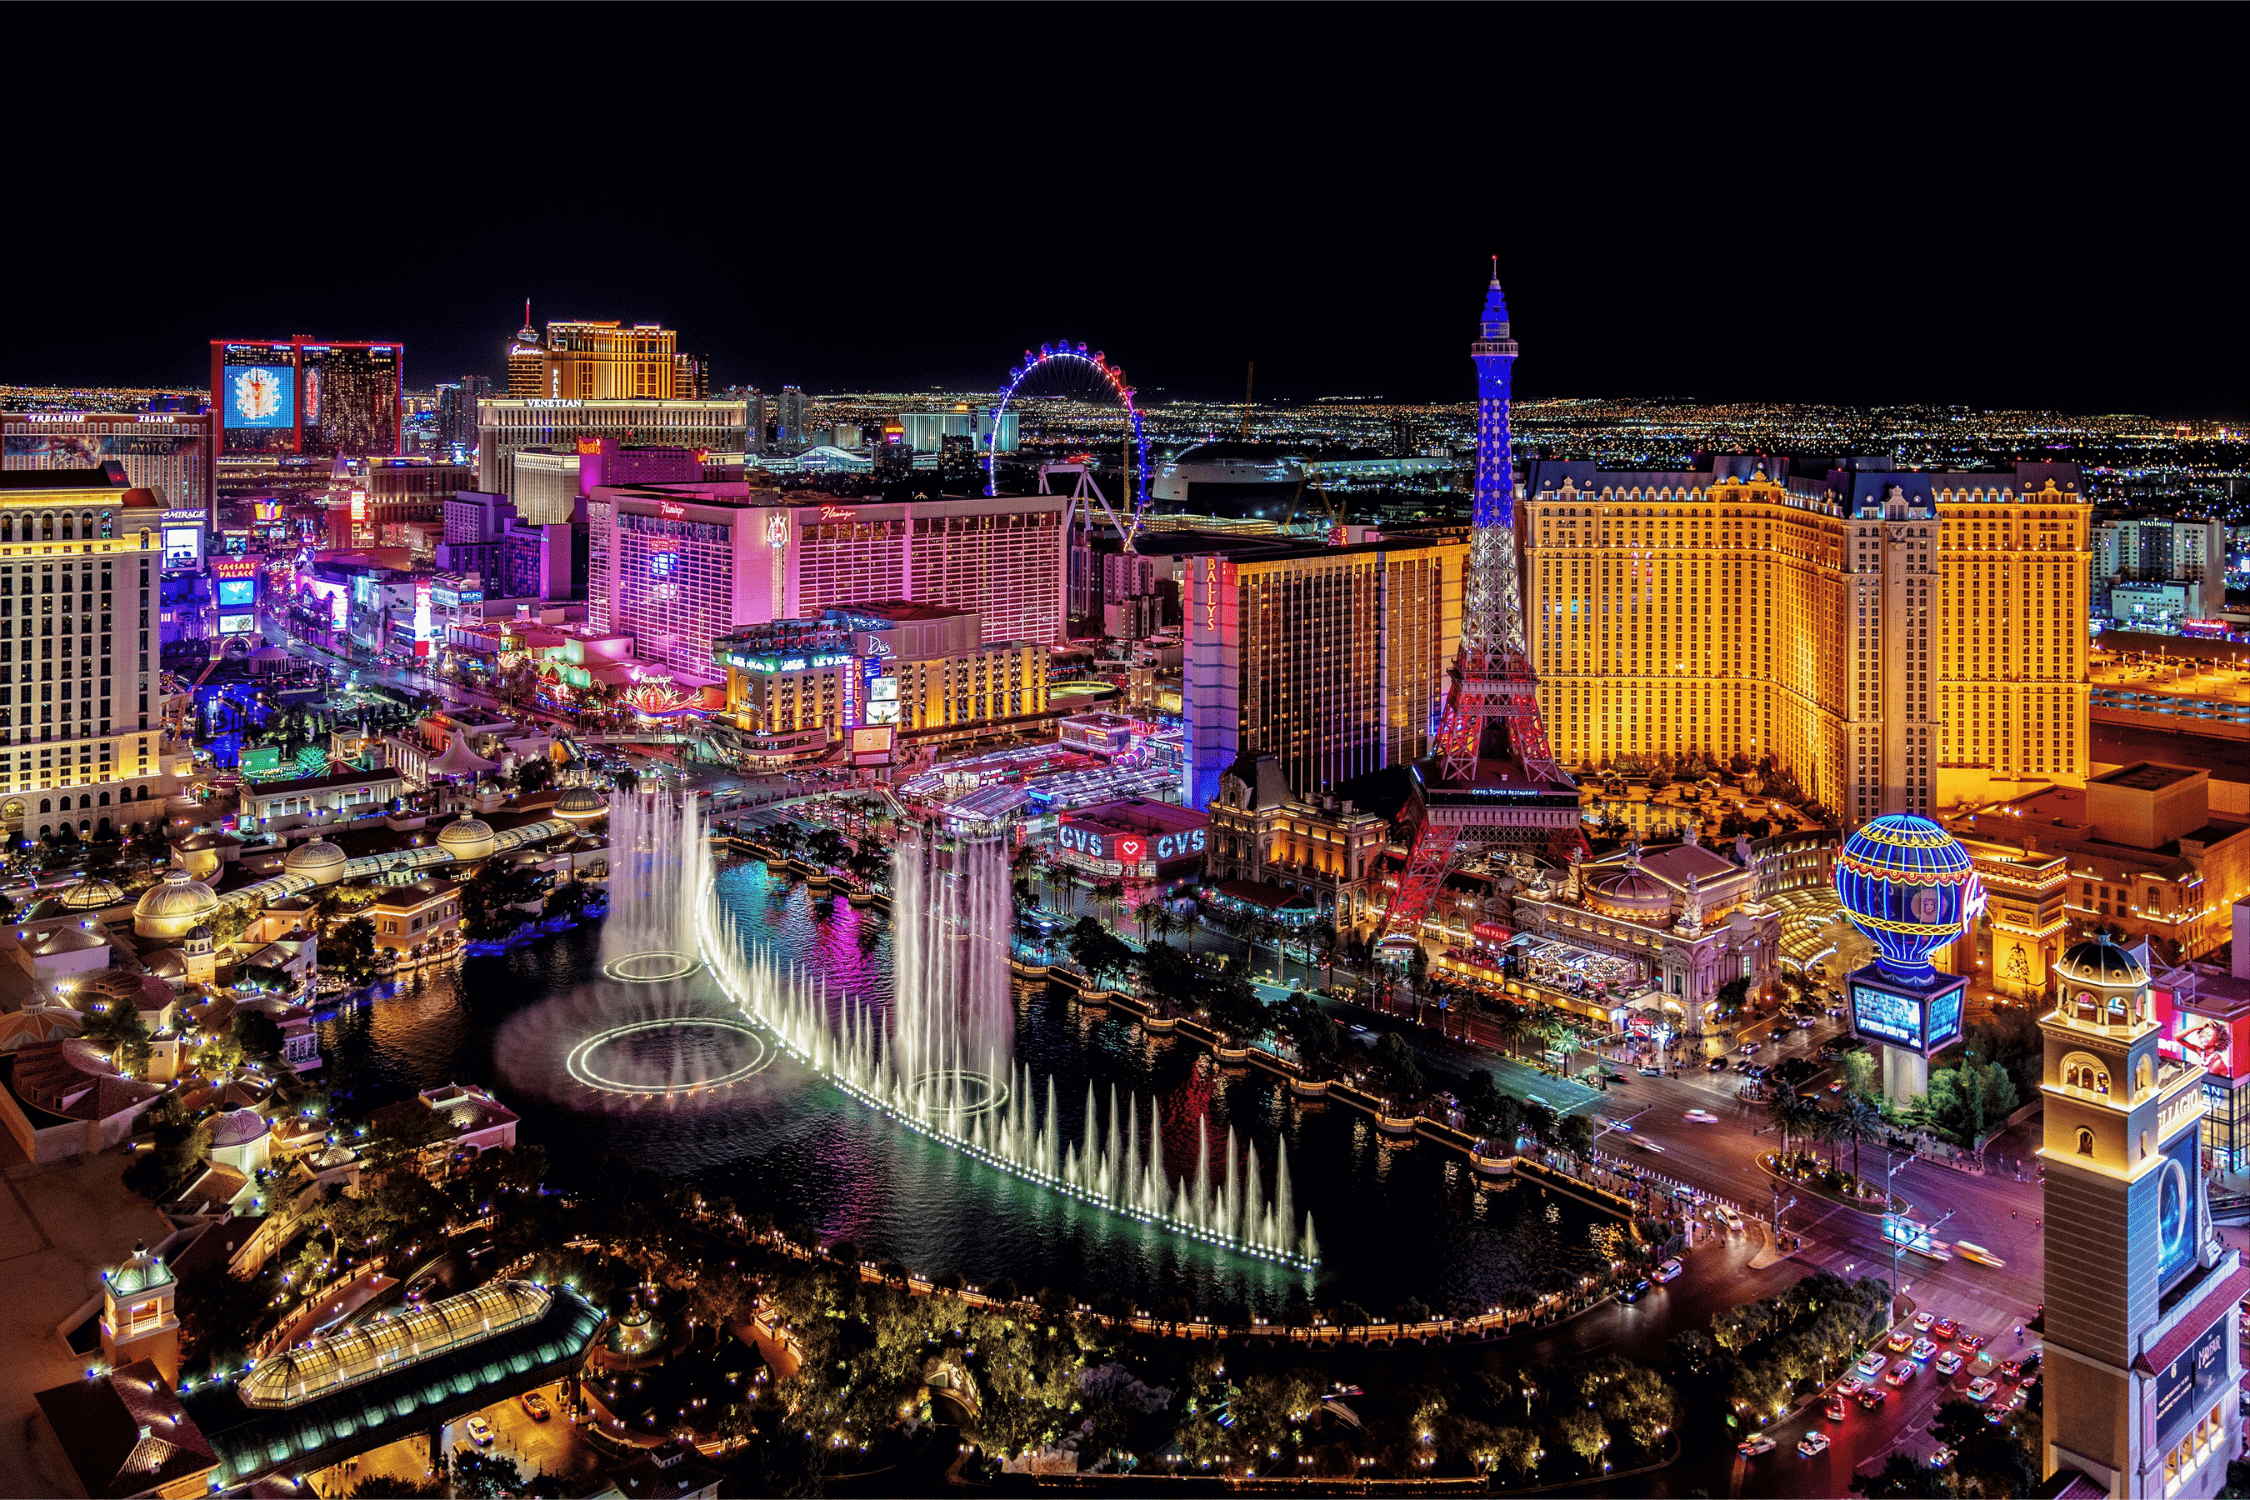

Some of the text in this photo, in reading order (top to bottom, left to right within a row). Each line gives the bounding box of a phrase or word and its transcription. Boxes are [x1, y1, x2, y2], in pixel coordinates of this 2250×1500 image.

[526, 399, 582, 408] VENETIAN
[28, 414, 175, 423] TREASURE ISLAND
[169, 511, 205, 519] MIRAGE
[820, 505, 856, 520] Flamingo
[2140, 517, 2172, 527] PLATINUM
[218, 563, 256, 571] CAESARS
[1059, 825, 1103, 857] CVS
[1157, 828, 1206, 858] CVS
[1473, 925, 1509, 941] BEER PARK
